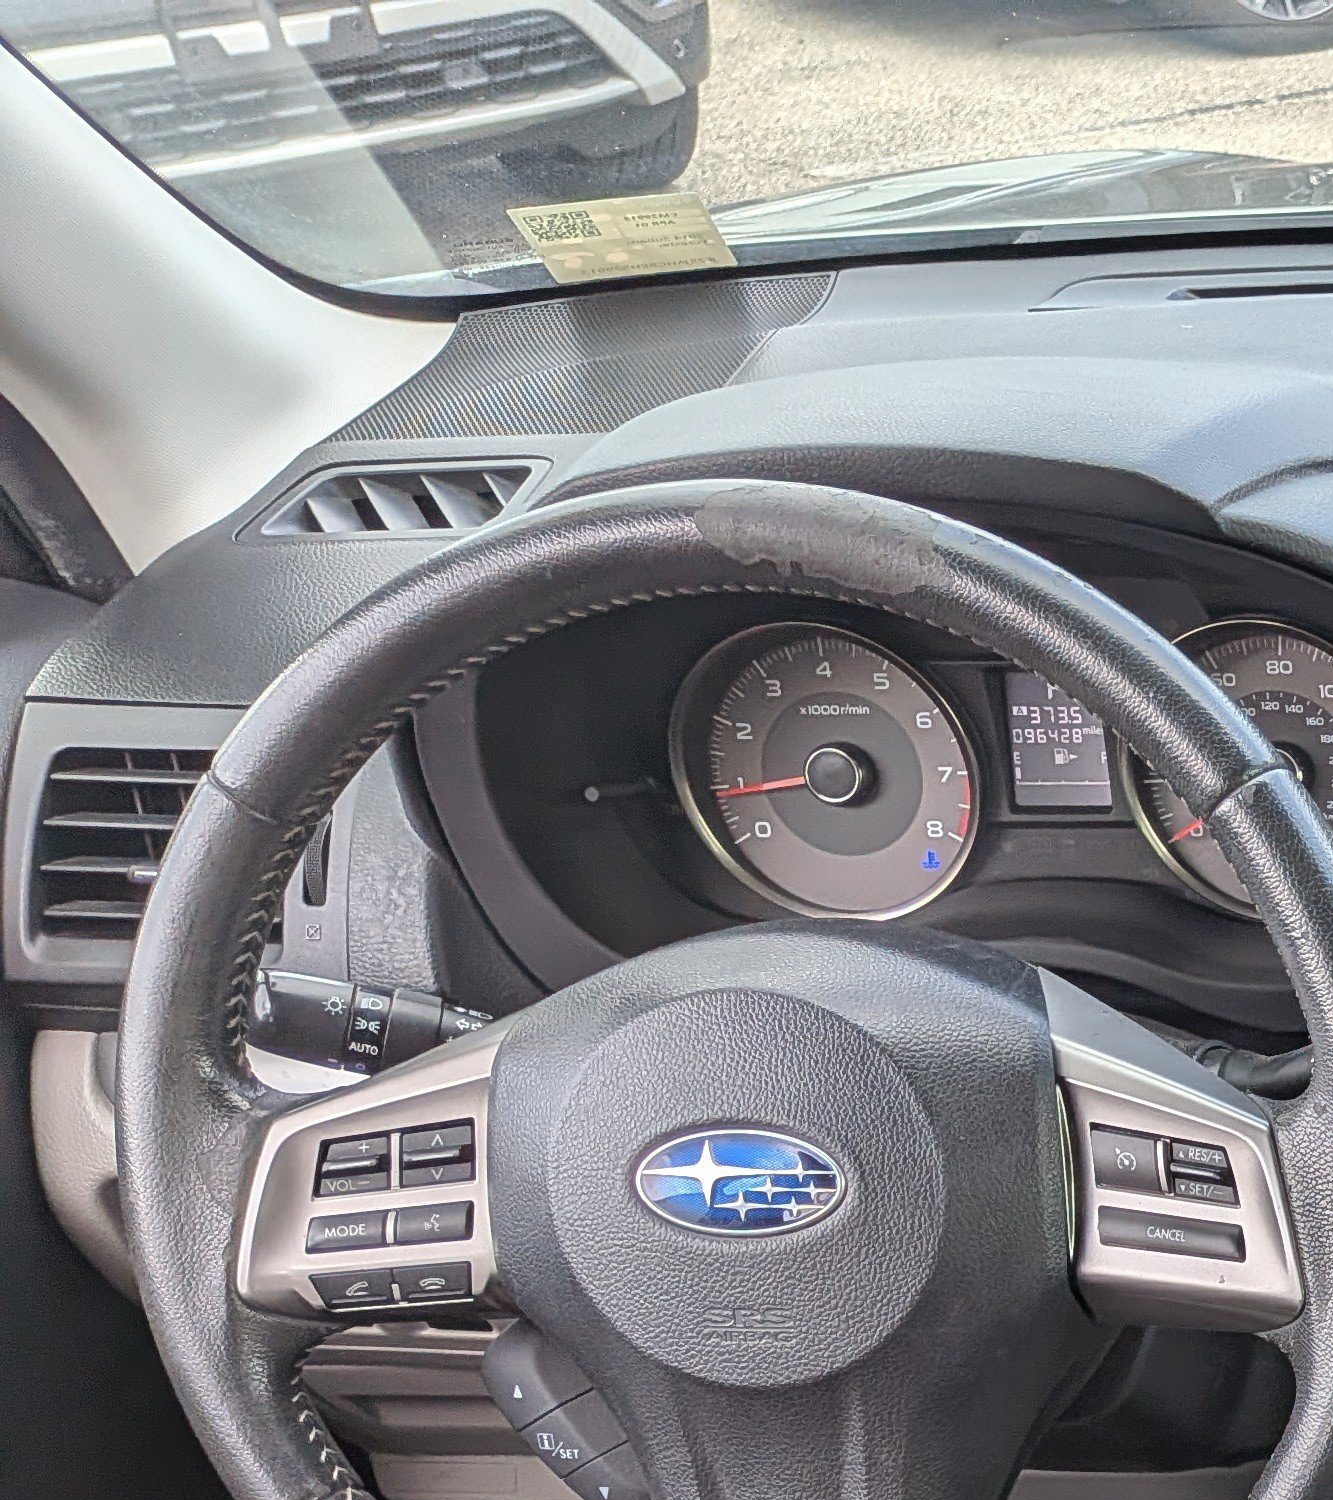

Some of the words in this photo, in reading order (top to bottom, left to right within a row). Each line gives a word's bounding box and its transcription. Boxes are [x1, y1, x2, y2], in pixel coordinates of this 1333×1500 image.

[815, 661, 832, 678] 4
[1266, 660, 1292, 675] 80
[766, 679, 782, 698] 3
[873, 673, 890, 690] 5
[1260, 701, 1280, 711] 120
[1284, 704, 1304, 714] 140
[915, 711, 932, 729] 6
[1029, 706, 1082, 724] 373.5
[1305, 717, 1325, 726] 160
[736, 722, 753, 740] 2
[1012, 728, 1083, 744] 096428
[1013, 751, 1022, 765] E
[937, 766, 953, 783] 7
[754, 821, 772, 838] 0
[926, 820, 944, 837] 8
[349, 1041, 379, 1056] AUTO
[324, 1223, 366, 1238] MODE
[1146, 1226, 1186, 1242] CANCEL
[702, 1306, 795, 1328] SRS
